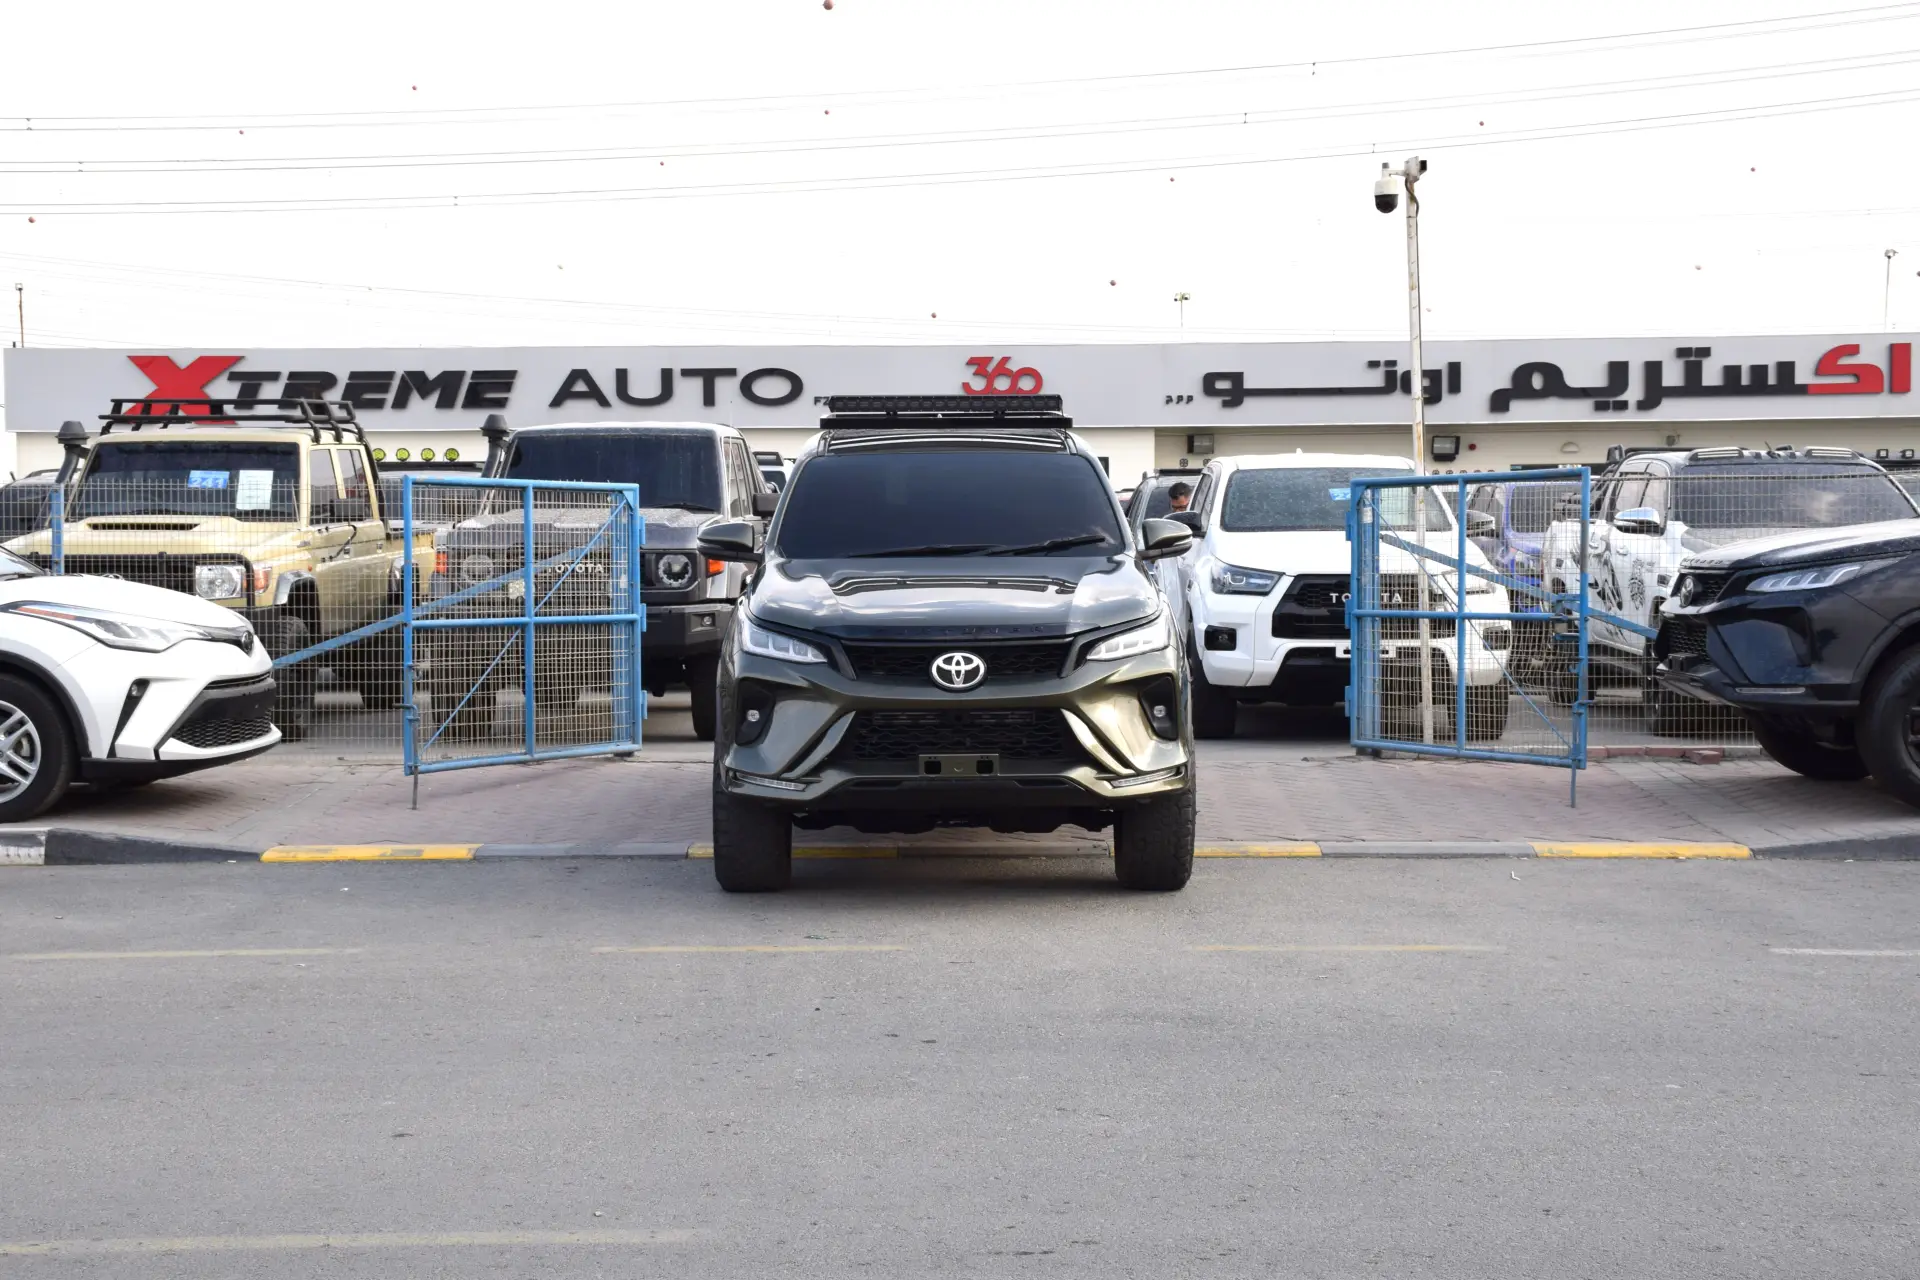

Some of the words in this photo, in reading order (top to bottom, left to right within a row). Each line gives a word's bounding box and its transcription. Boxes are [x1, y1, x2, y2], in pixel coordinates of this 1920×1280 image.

[121, 355, 518, 425] XTREME
[548, 367, 804, 408] AUTO
[962, 356, 1043, 395] 360
[1489, 343, 1911, 412] اكستريم
[1329, 593, 1402, 604] TOTA
